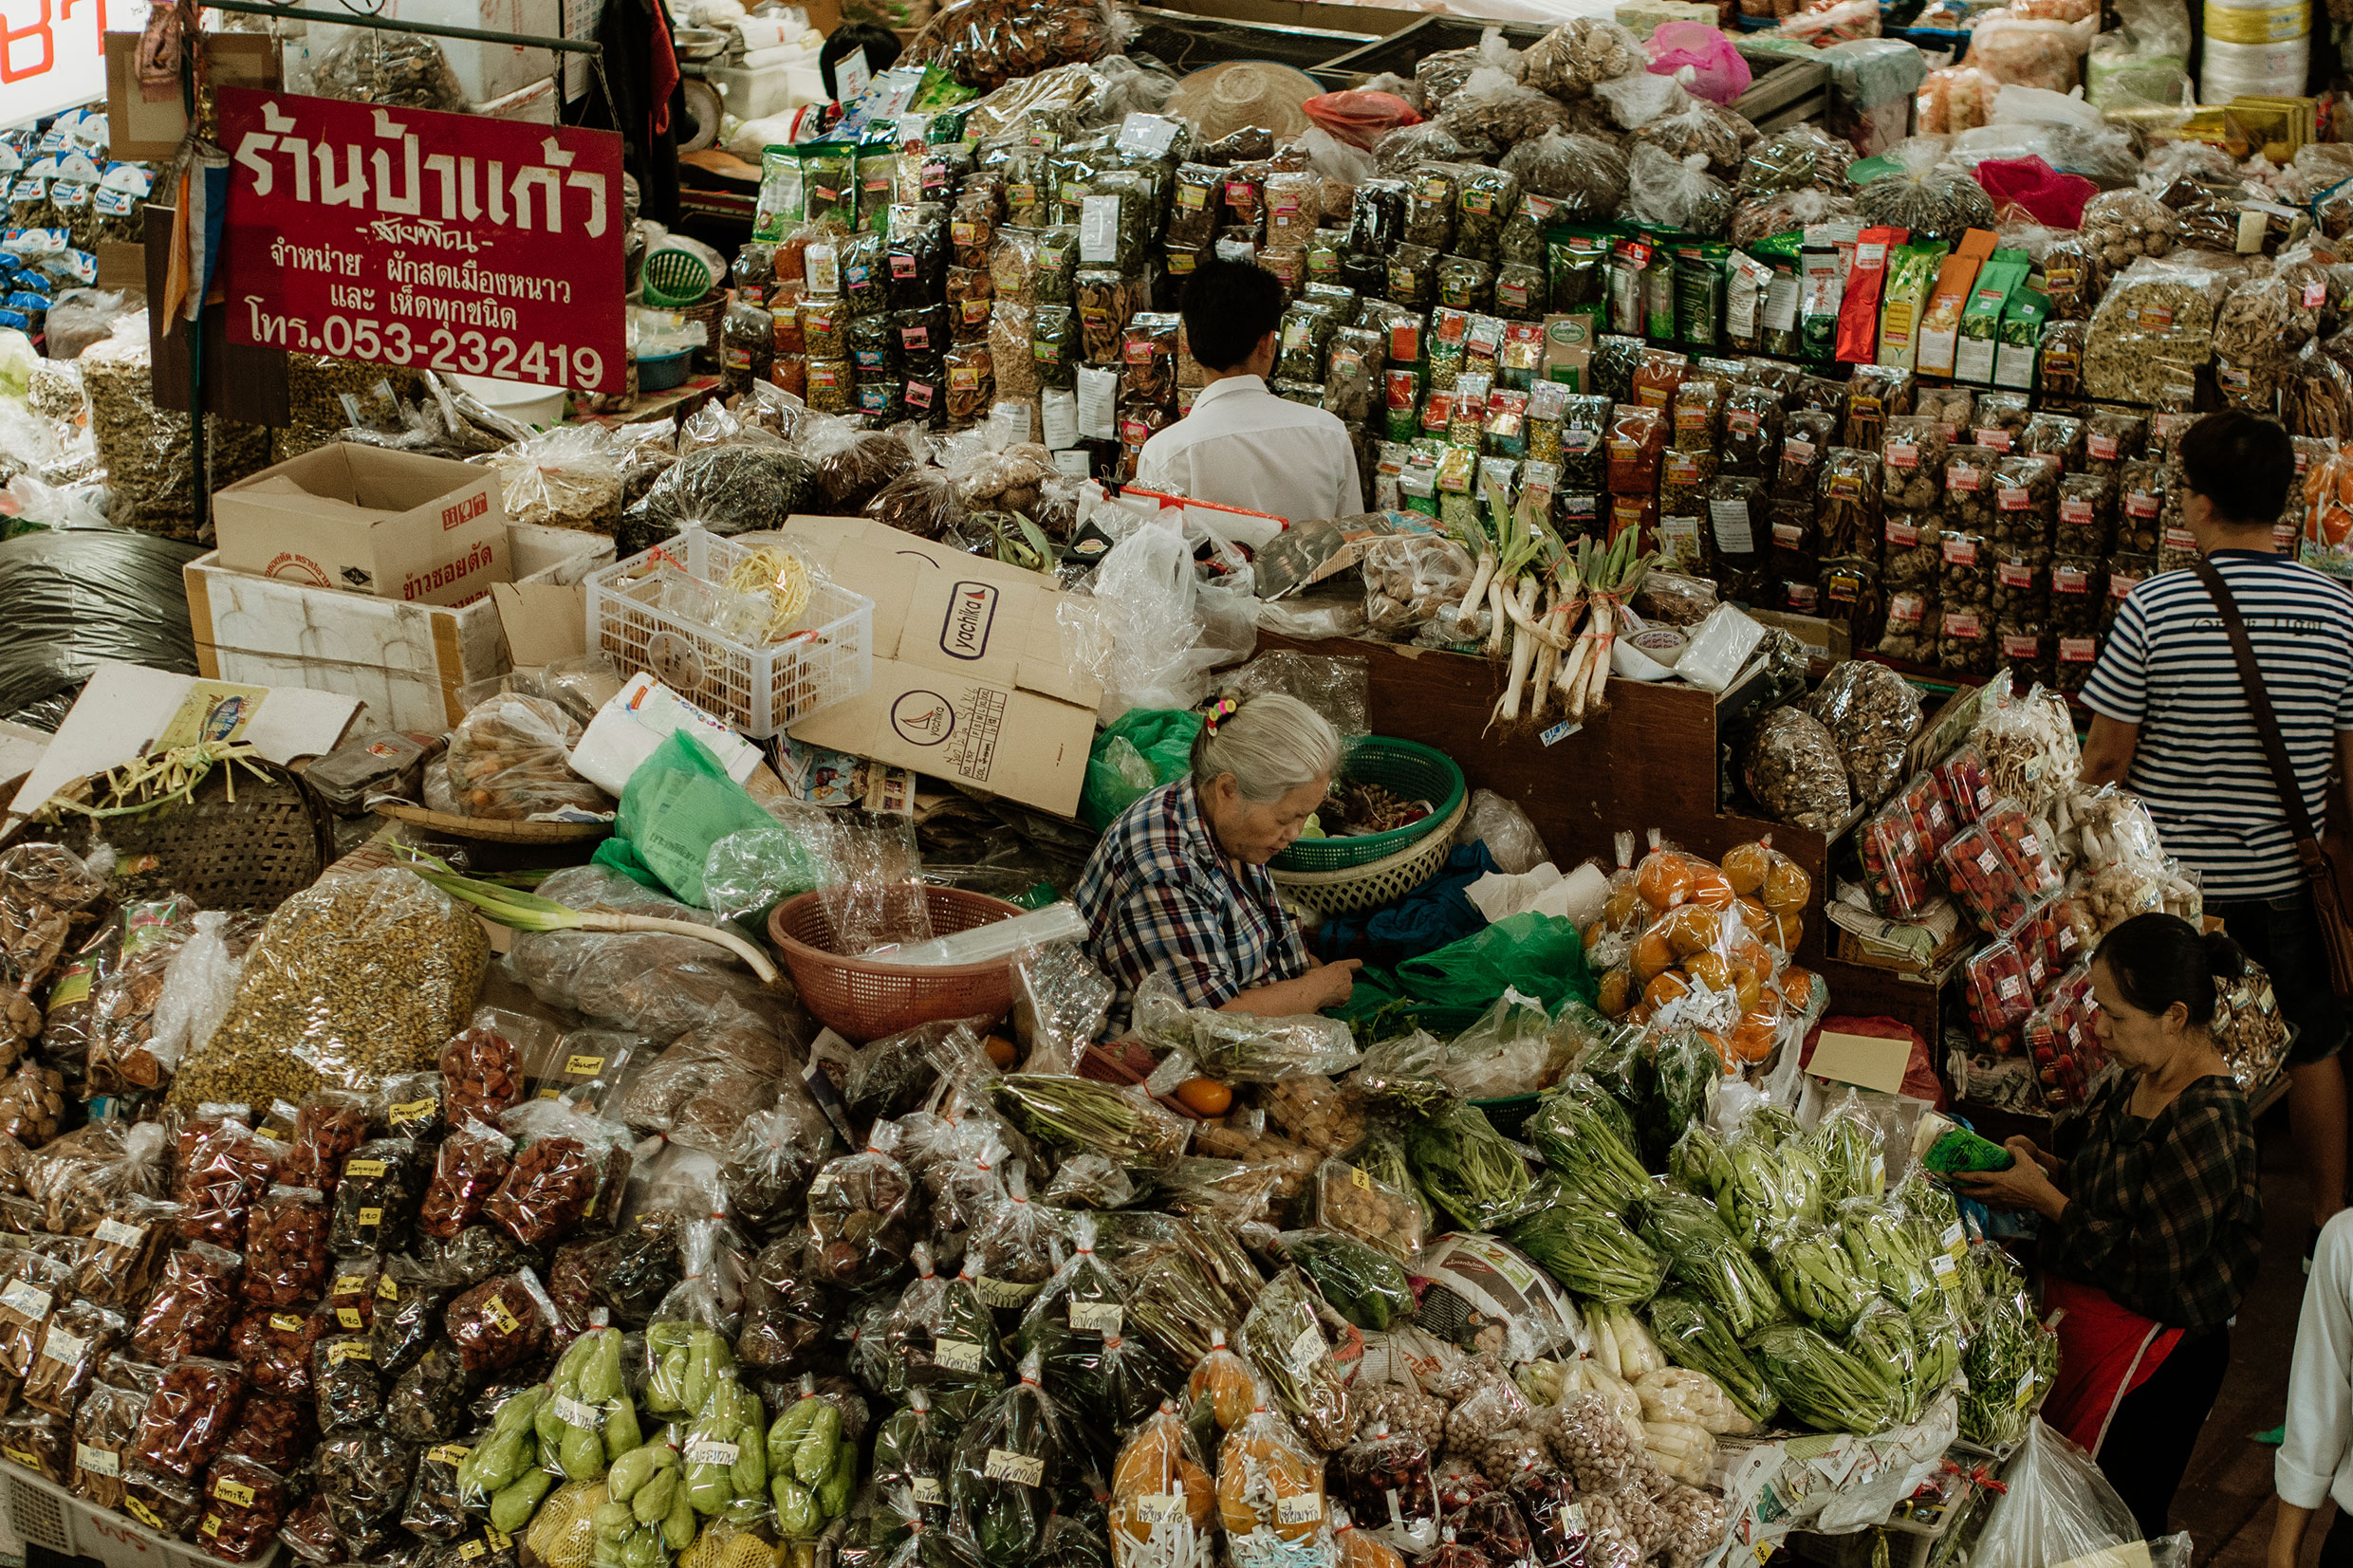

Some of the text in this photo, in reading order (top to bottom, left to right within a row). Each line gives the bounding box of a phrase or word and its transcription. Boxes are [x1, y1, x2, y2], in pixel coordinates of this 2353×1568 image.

[233, 99, 608, 239] ร้านป้าแก้ว
[269, 235, 572, 304] จำหน่าย ผักสดเมืองหนาว
[329, 284, 519, 332] และ เห็ดทุกชนิด
[243, 295, 604, 390] โทร.053-232419
[955, 599, 983, 652] yachika
[929, 706, 946, 738] yachika
